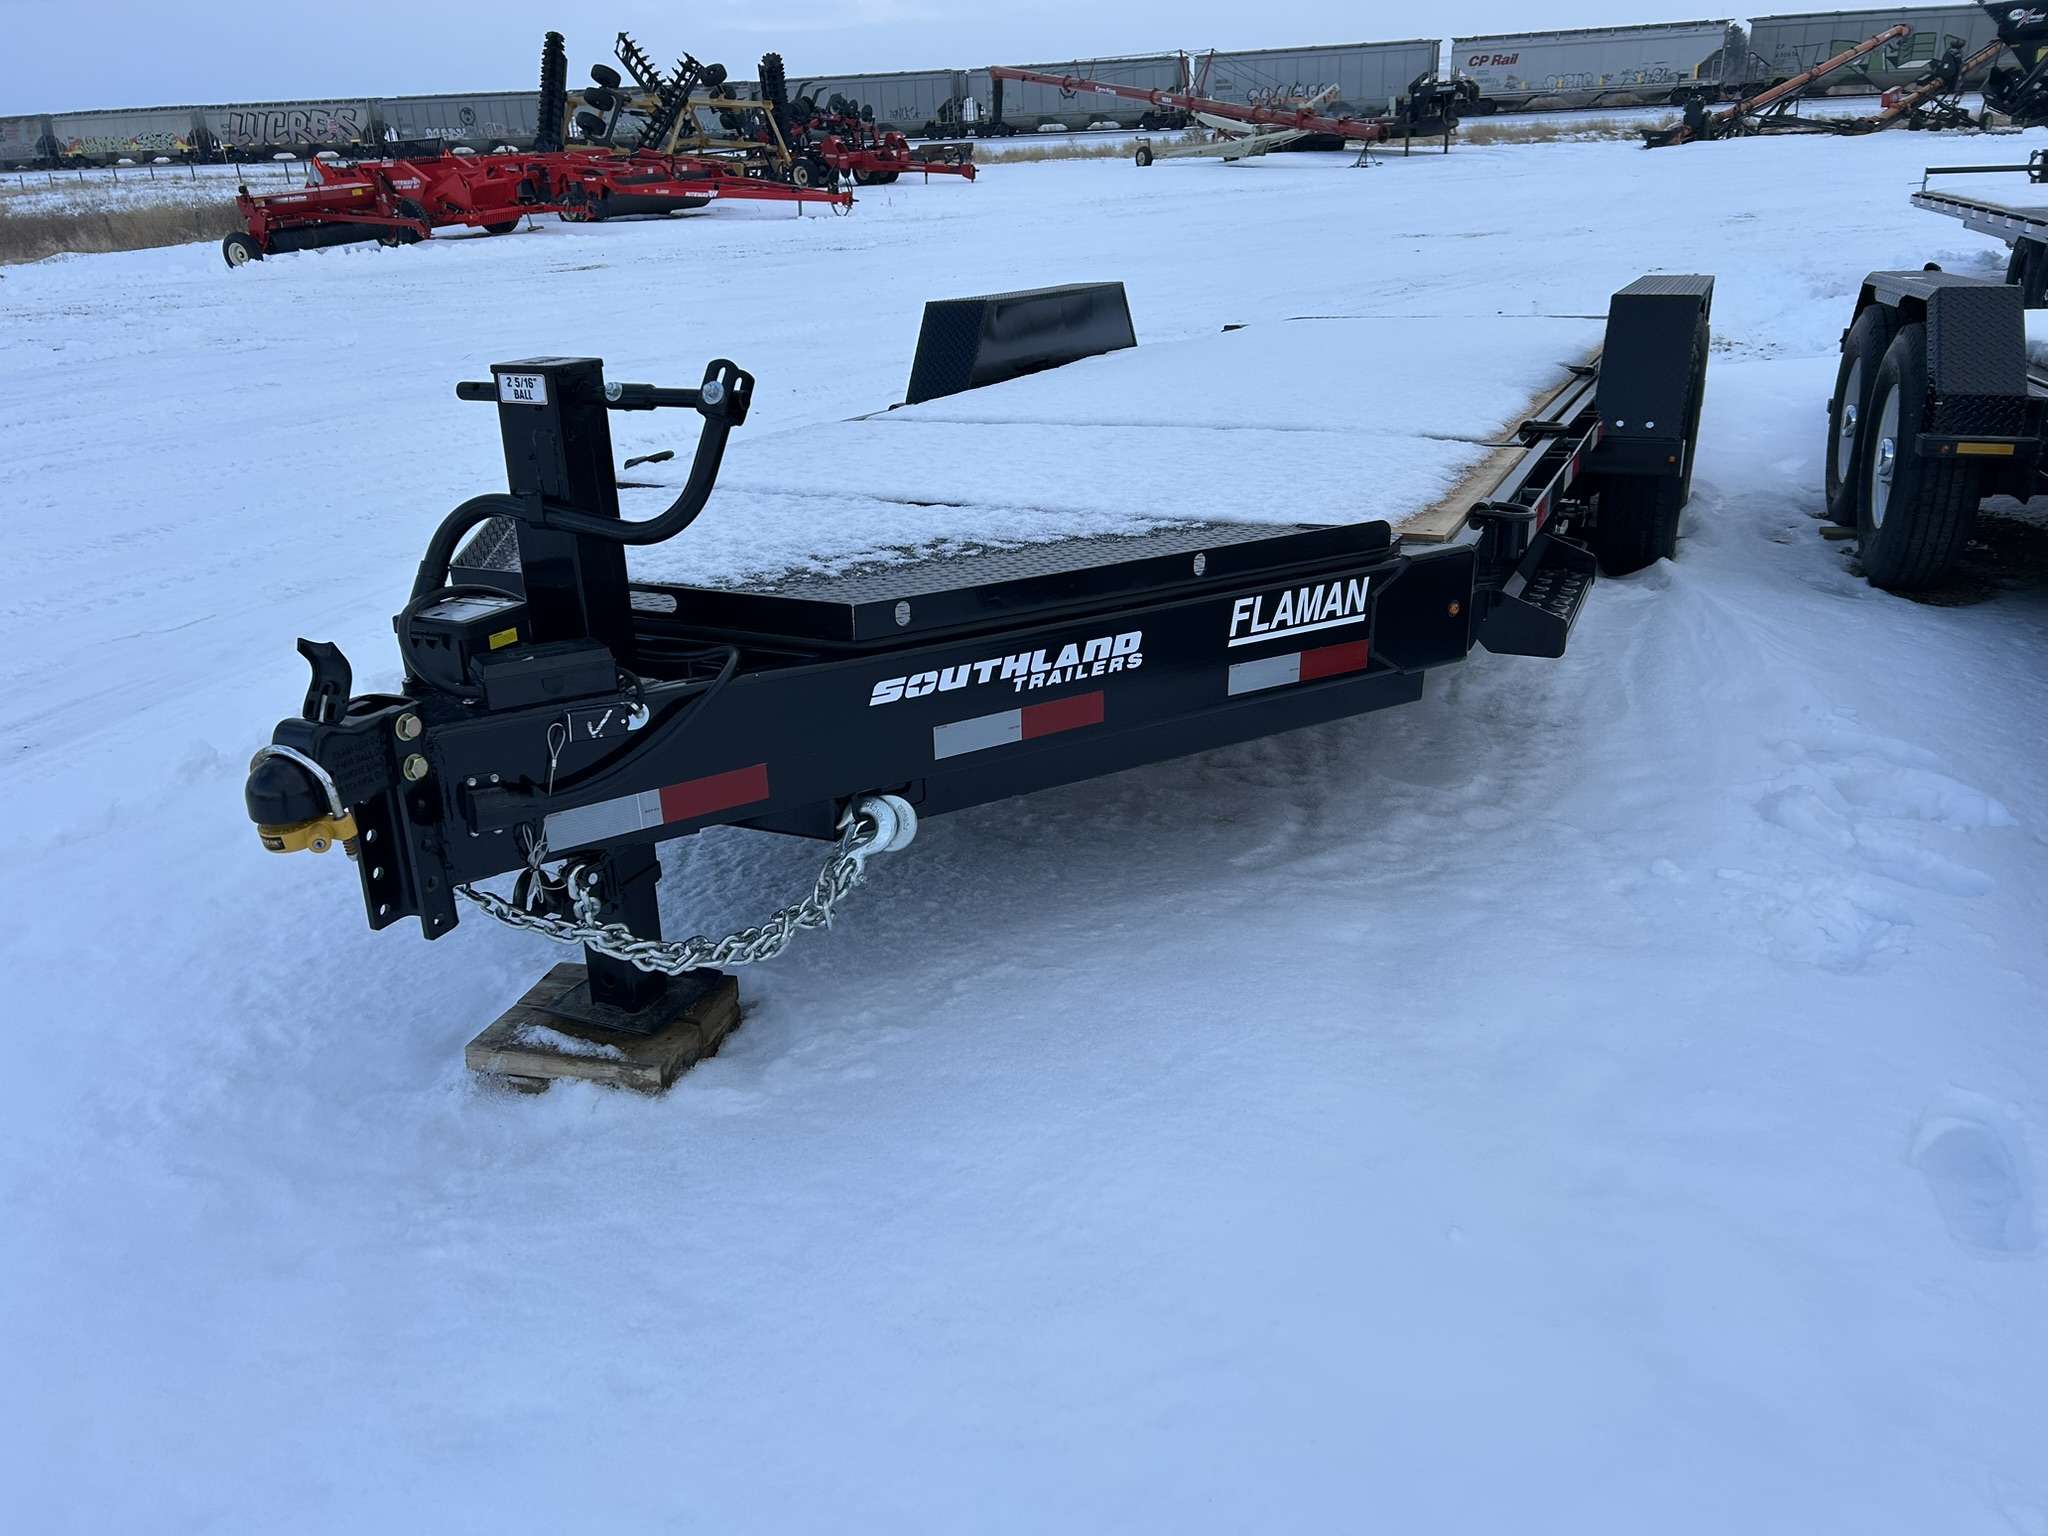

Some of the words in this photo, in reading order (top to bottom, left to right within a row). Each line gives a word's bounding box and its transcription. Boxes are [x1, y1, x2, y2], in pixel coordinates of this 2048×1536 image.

[1468, 55, 1489, 66] CP
[1491, 53, 1519, 65] Rail
[507, 377, 513, 387] 2
[514, 377, 537, 388] 5/16"
[514, 390, 534, 400] BALL
[1229, 576, 1370, 637] FLAMAN
[869, 630, 1142, 706] SOUTHLAND
[1013, 652, 1142, 692] TRAILERS
